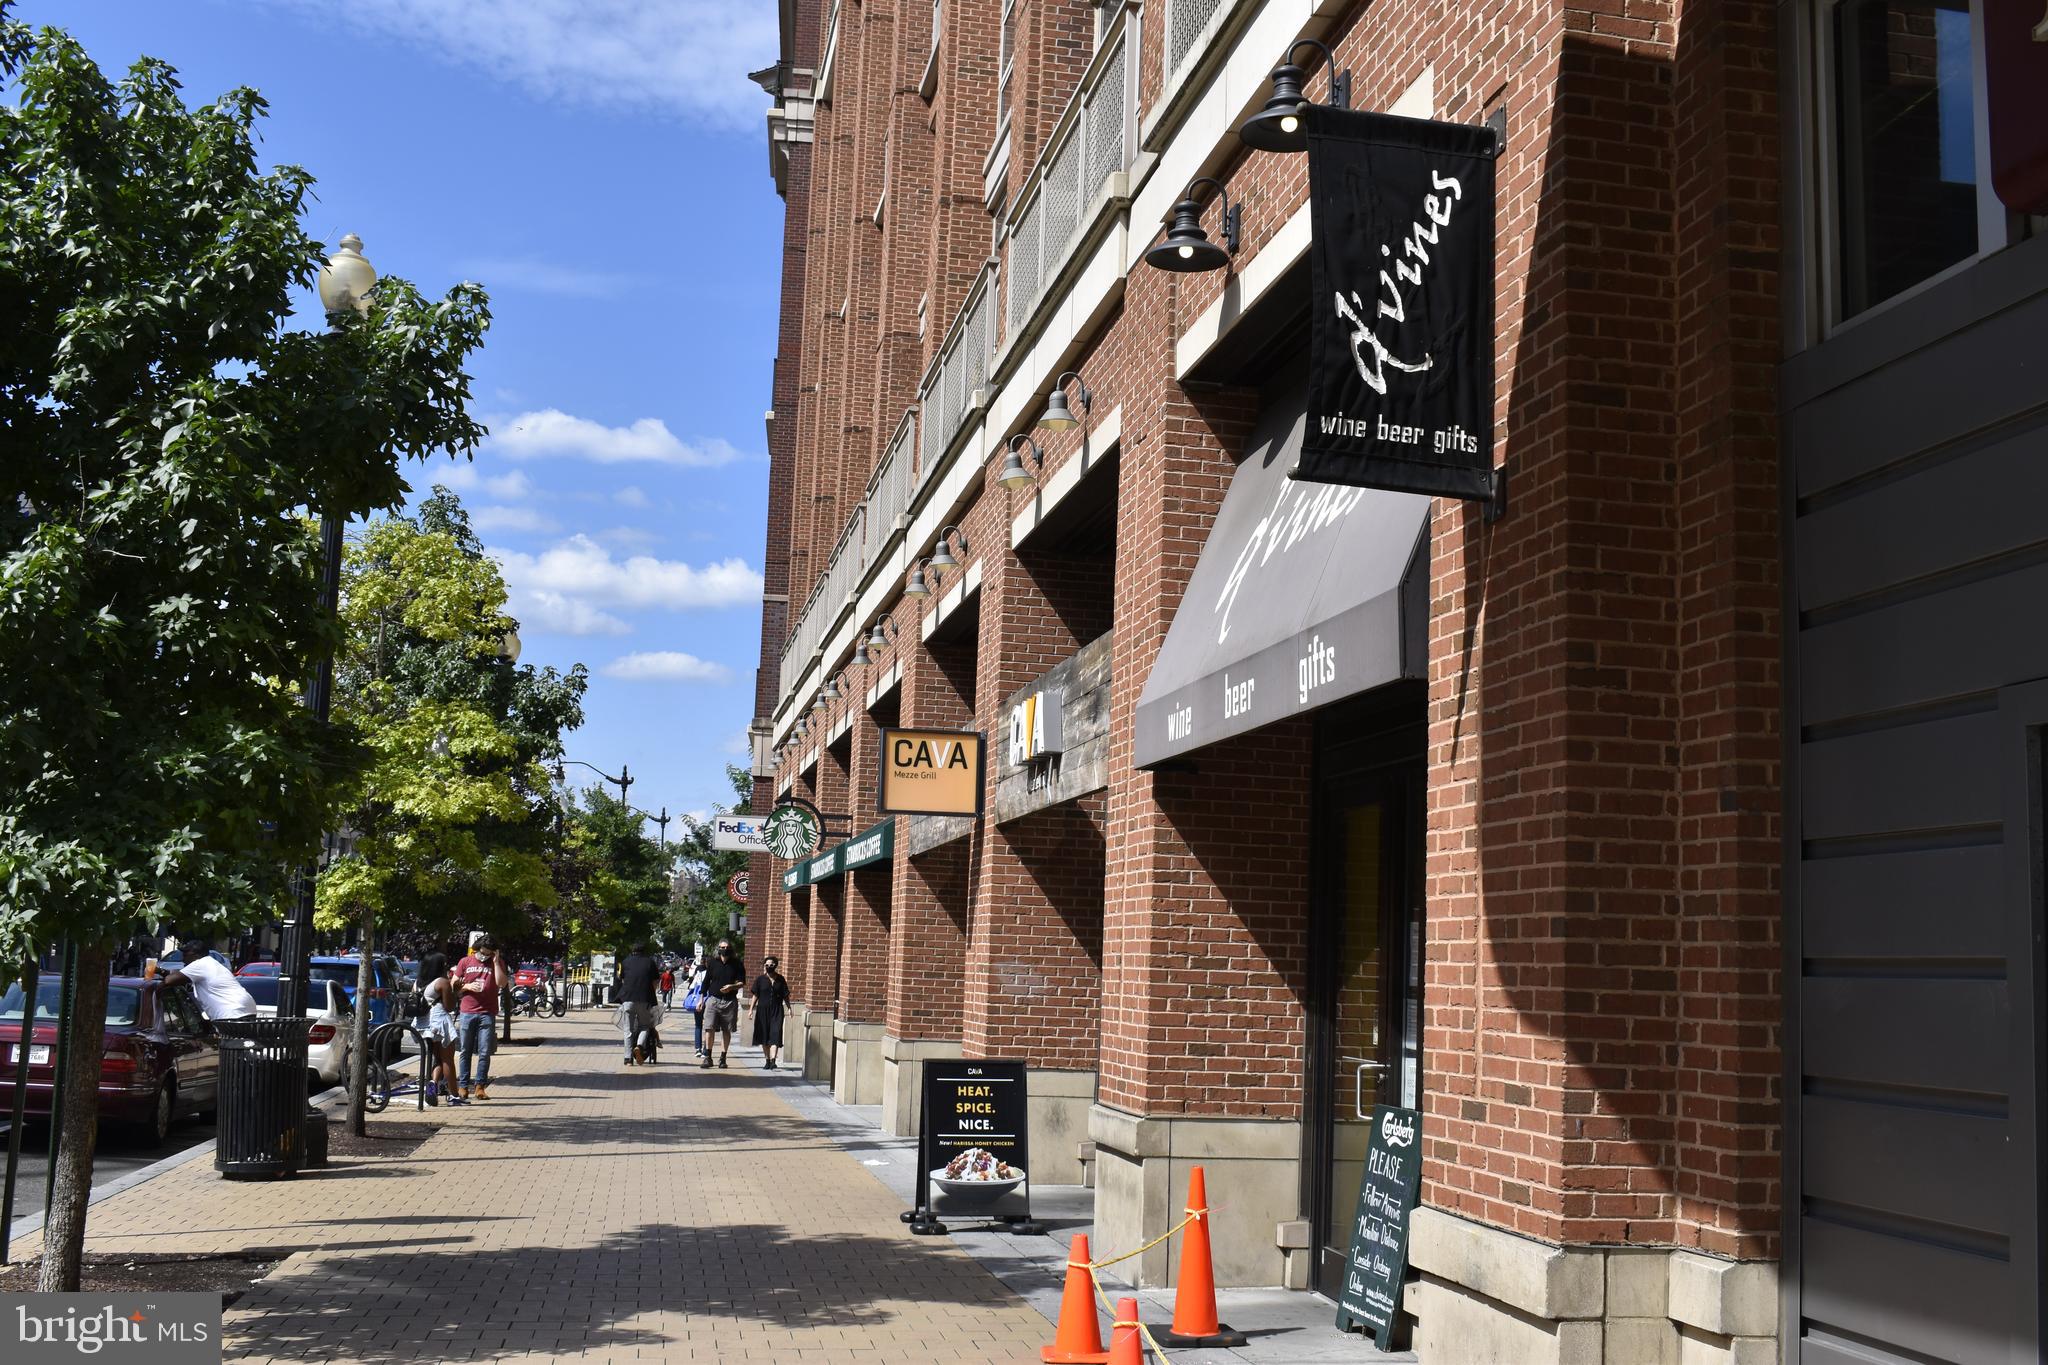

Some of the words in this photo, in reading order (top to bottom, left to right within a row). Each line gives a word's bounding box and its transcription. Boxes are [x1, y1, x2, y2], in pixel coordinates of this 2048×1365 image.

[1320, 414, 1367, 438] wine
[1377, 414, 1425, 446] beer
[1433, 428, 1478, 454] gifts
[1167, 702, 1192, 742] wine
[1224, 673, 1255, 719] beer
[1299, 634, 1336, 704] gifts
[894, 739, 968, 770] CAVA
[894, 770, 919, 779] Mezze
[920, 770, 937, 780] Grill
[718, 821, 755, 833] FedEx
[738, 834, 767, 845] Office
[731, 871, 750, 884] CHIPO
[957, 1086, 994, 1097] HEAT.
[956, 1103, 996, 1113] SPICE.
[958, 1119, 994, 1130] NICE.
[1381, 1111, 1415, 1146] Carlsberg
